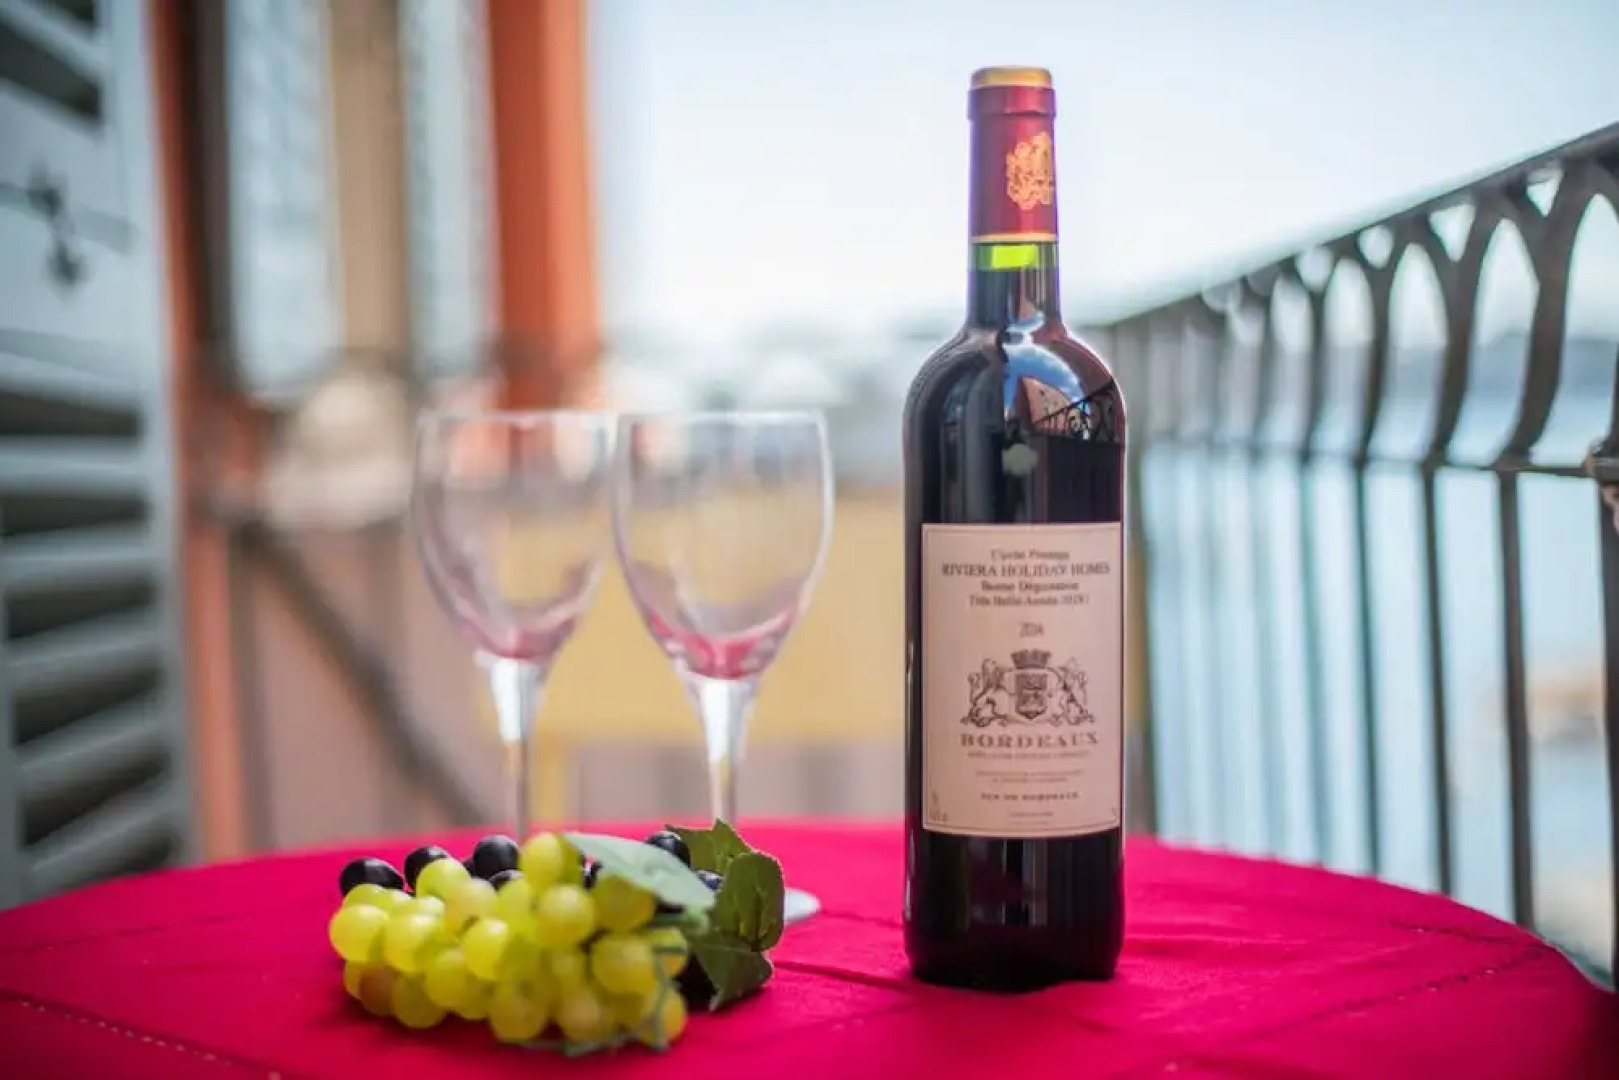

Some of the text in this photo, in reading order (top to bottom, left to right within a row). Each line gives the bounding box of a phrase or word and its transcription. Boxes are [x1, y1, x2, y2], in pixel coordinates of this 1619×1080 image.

[942, 562, 1110, 576] RIVIERA HOLIDAY HOMES
[960, 732, 1099, 748] BORDEAUX
